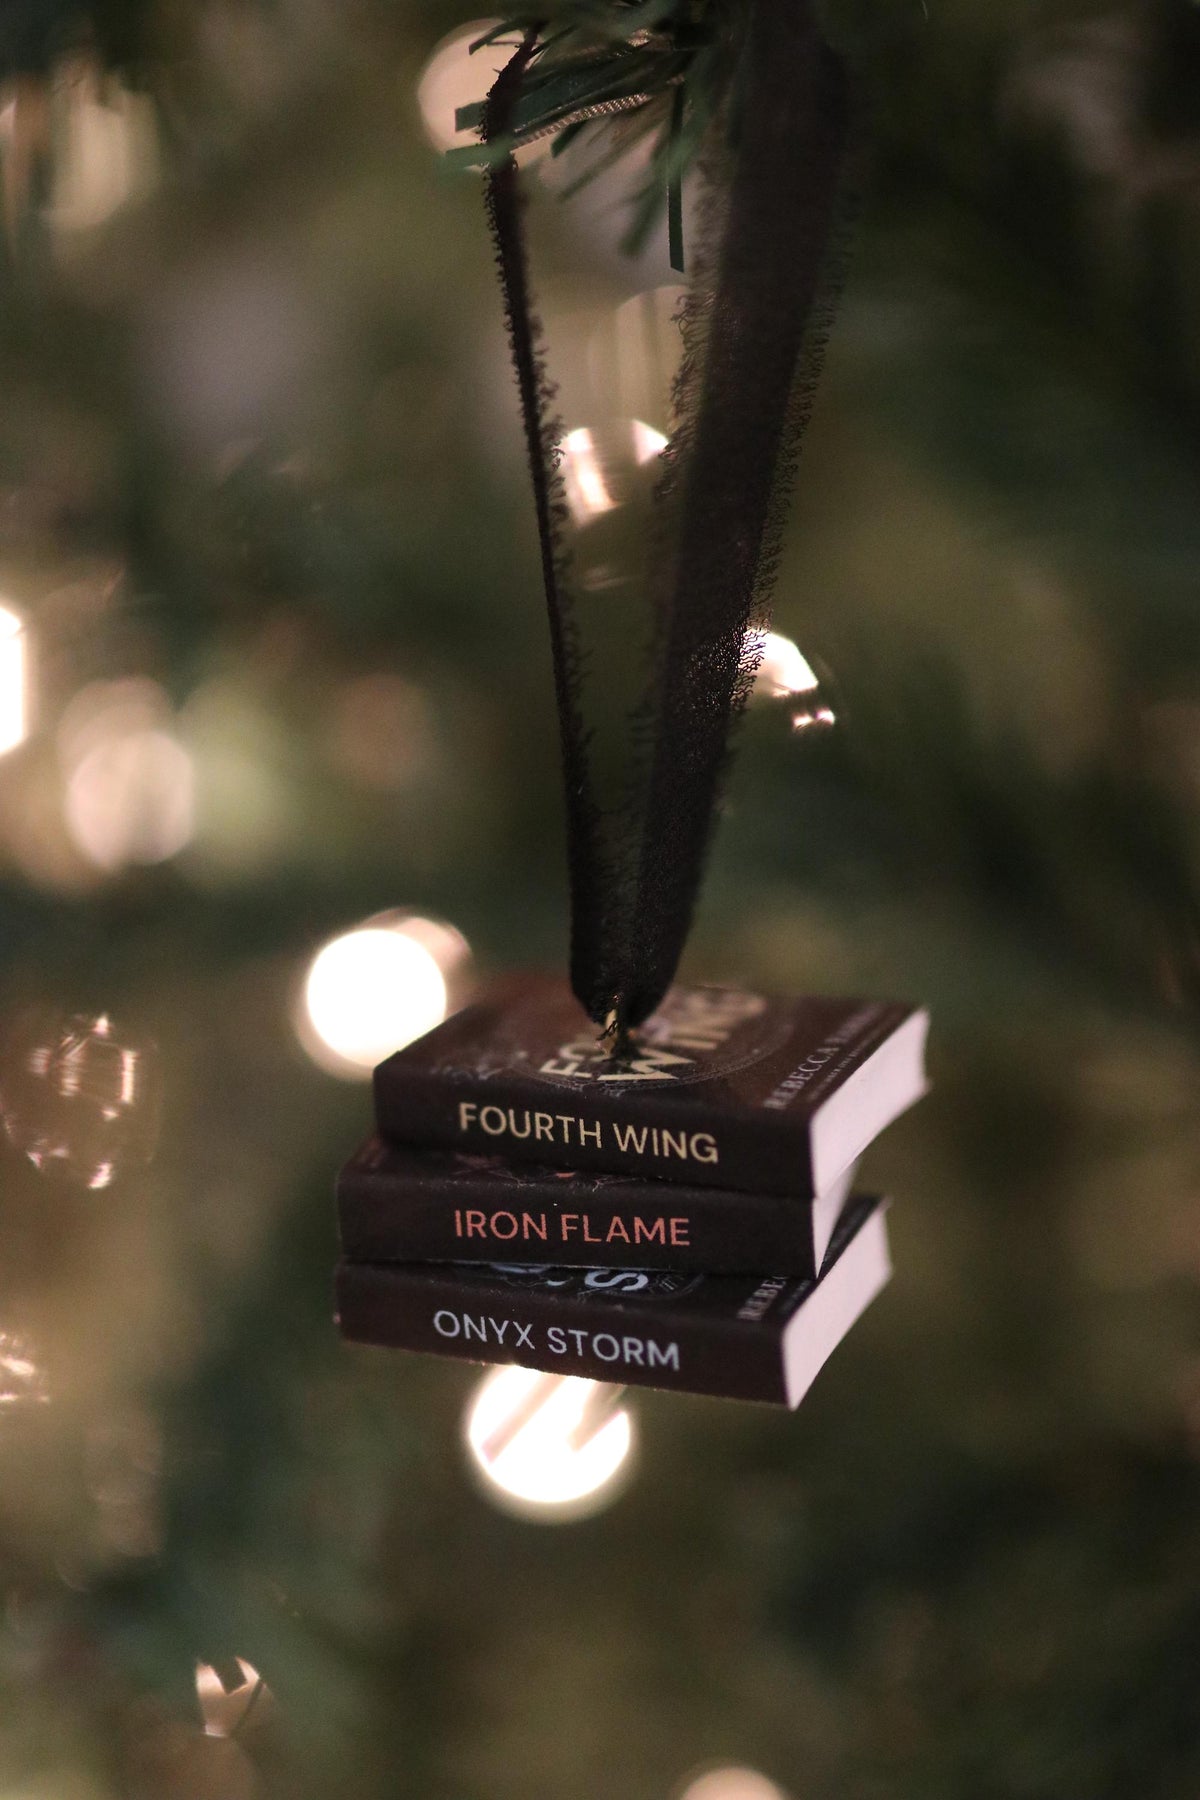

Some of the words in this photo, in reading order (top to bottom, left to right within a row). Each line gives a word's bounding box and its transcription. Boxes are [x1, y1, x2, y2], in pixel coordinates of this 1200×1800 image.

[459, 1102, 602, 1149] FOURTH
[612, 1122, 719, 1164] WING
[454, 1209, 548, 1240] IRON
[560, 1213, 690, 1246] FLAME
[433, 1311, 536, 1350] ONYX
[547, 1326, 680, 1372] STORM
